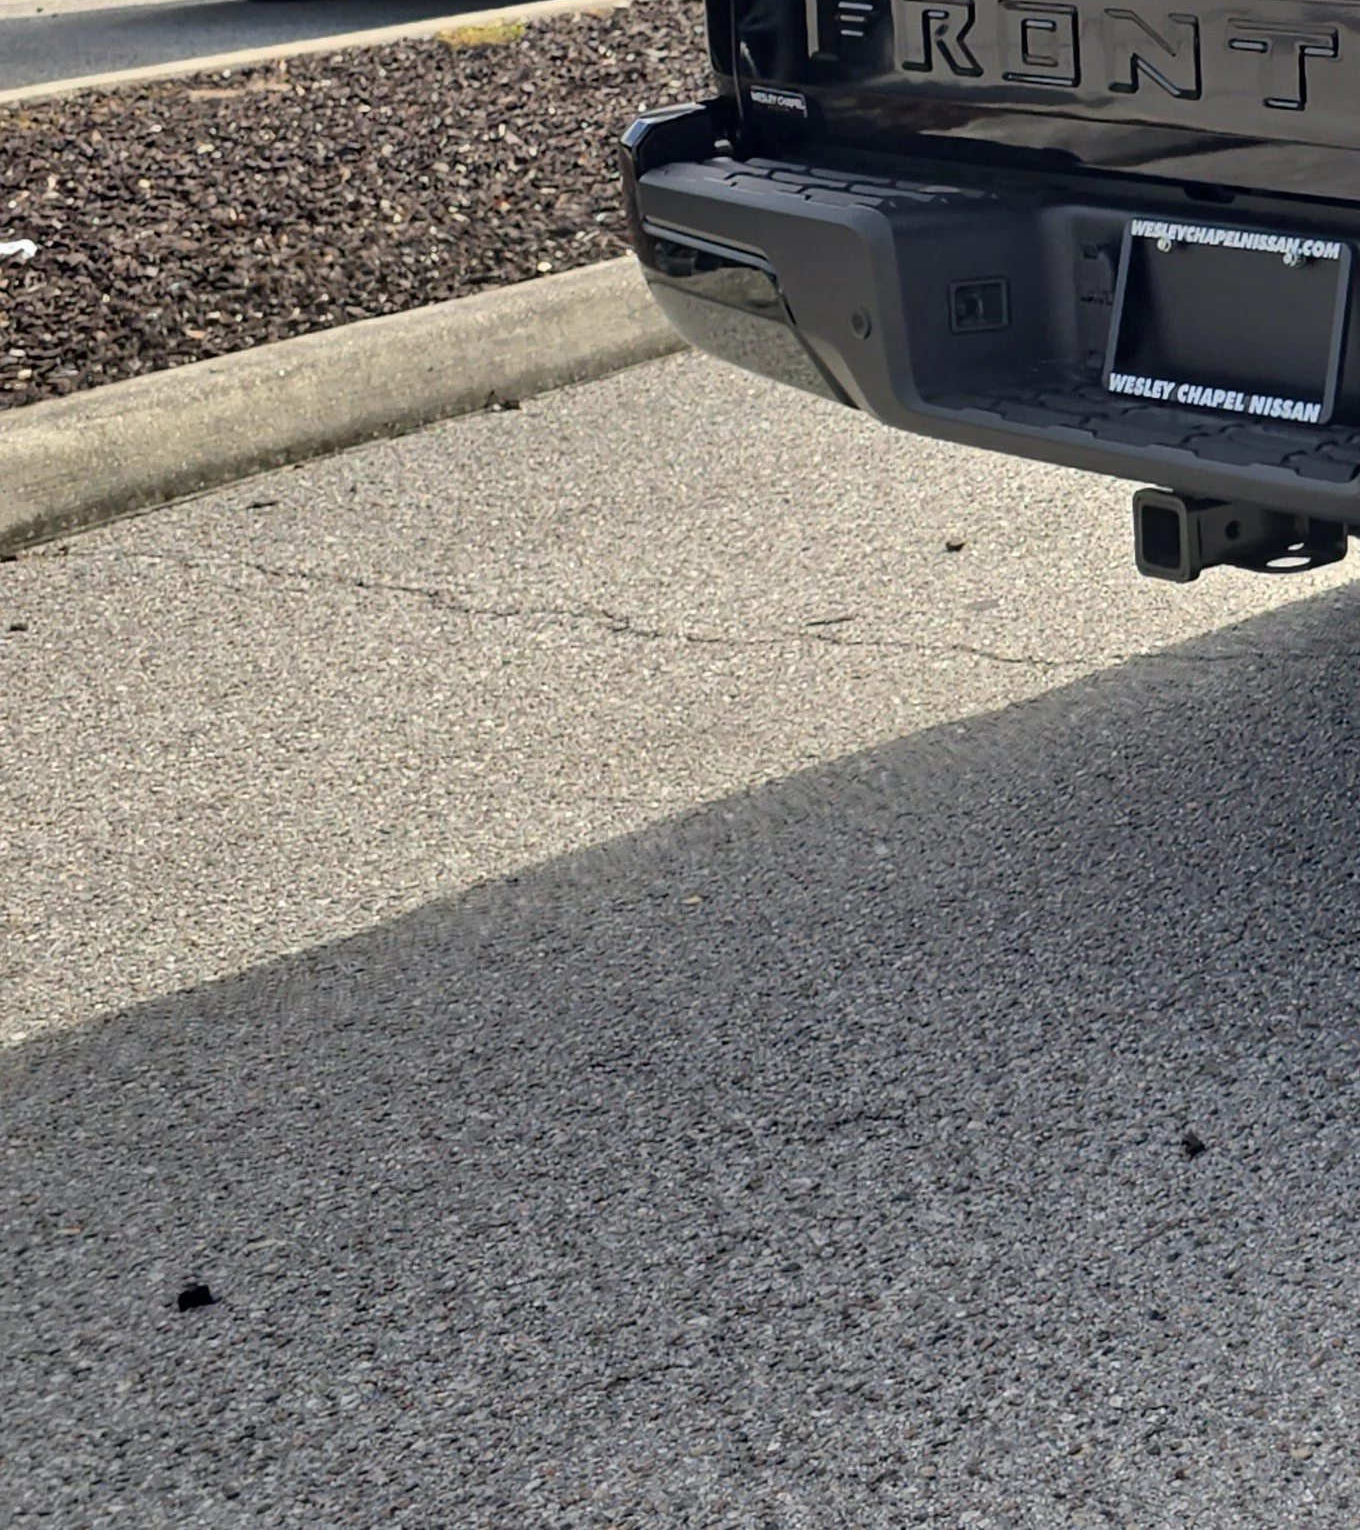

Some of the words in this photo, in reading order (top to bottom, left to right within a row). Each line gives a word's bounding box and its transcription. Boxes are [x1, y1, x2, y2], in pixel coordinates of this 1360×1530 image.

[1131, 219, 1341, 260] WESLEYCHAPELNISSAN.COM
[1108, 372, 1175, 401] WESLEY
[1176, 383, 1245, 412] CHAPEL
[1248, 396, 1322, 423] NISSAN
